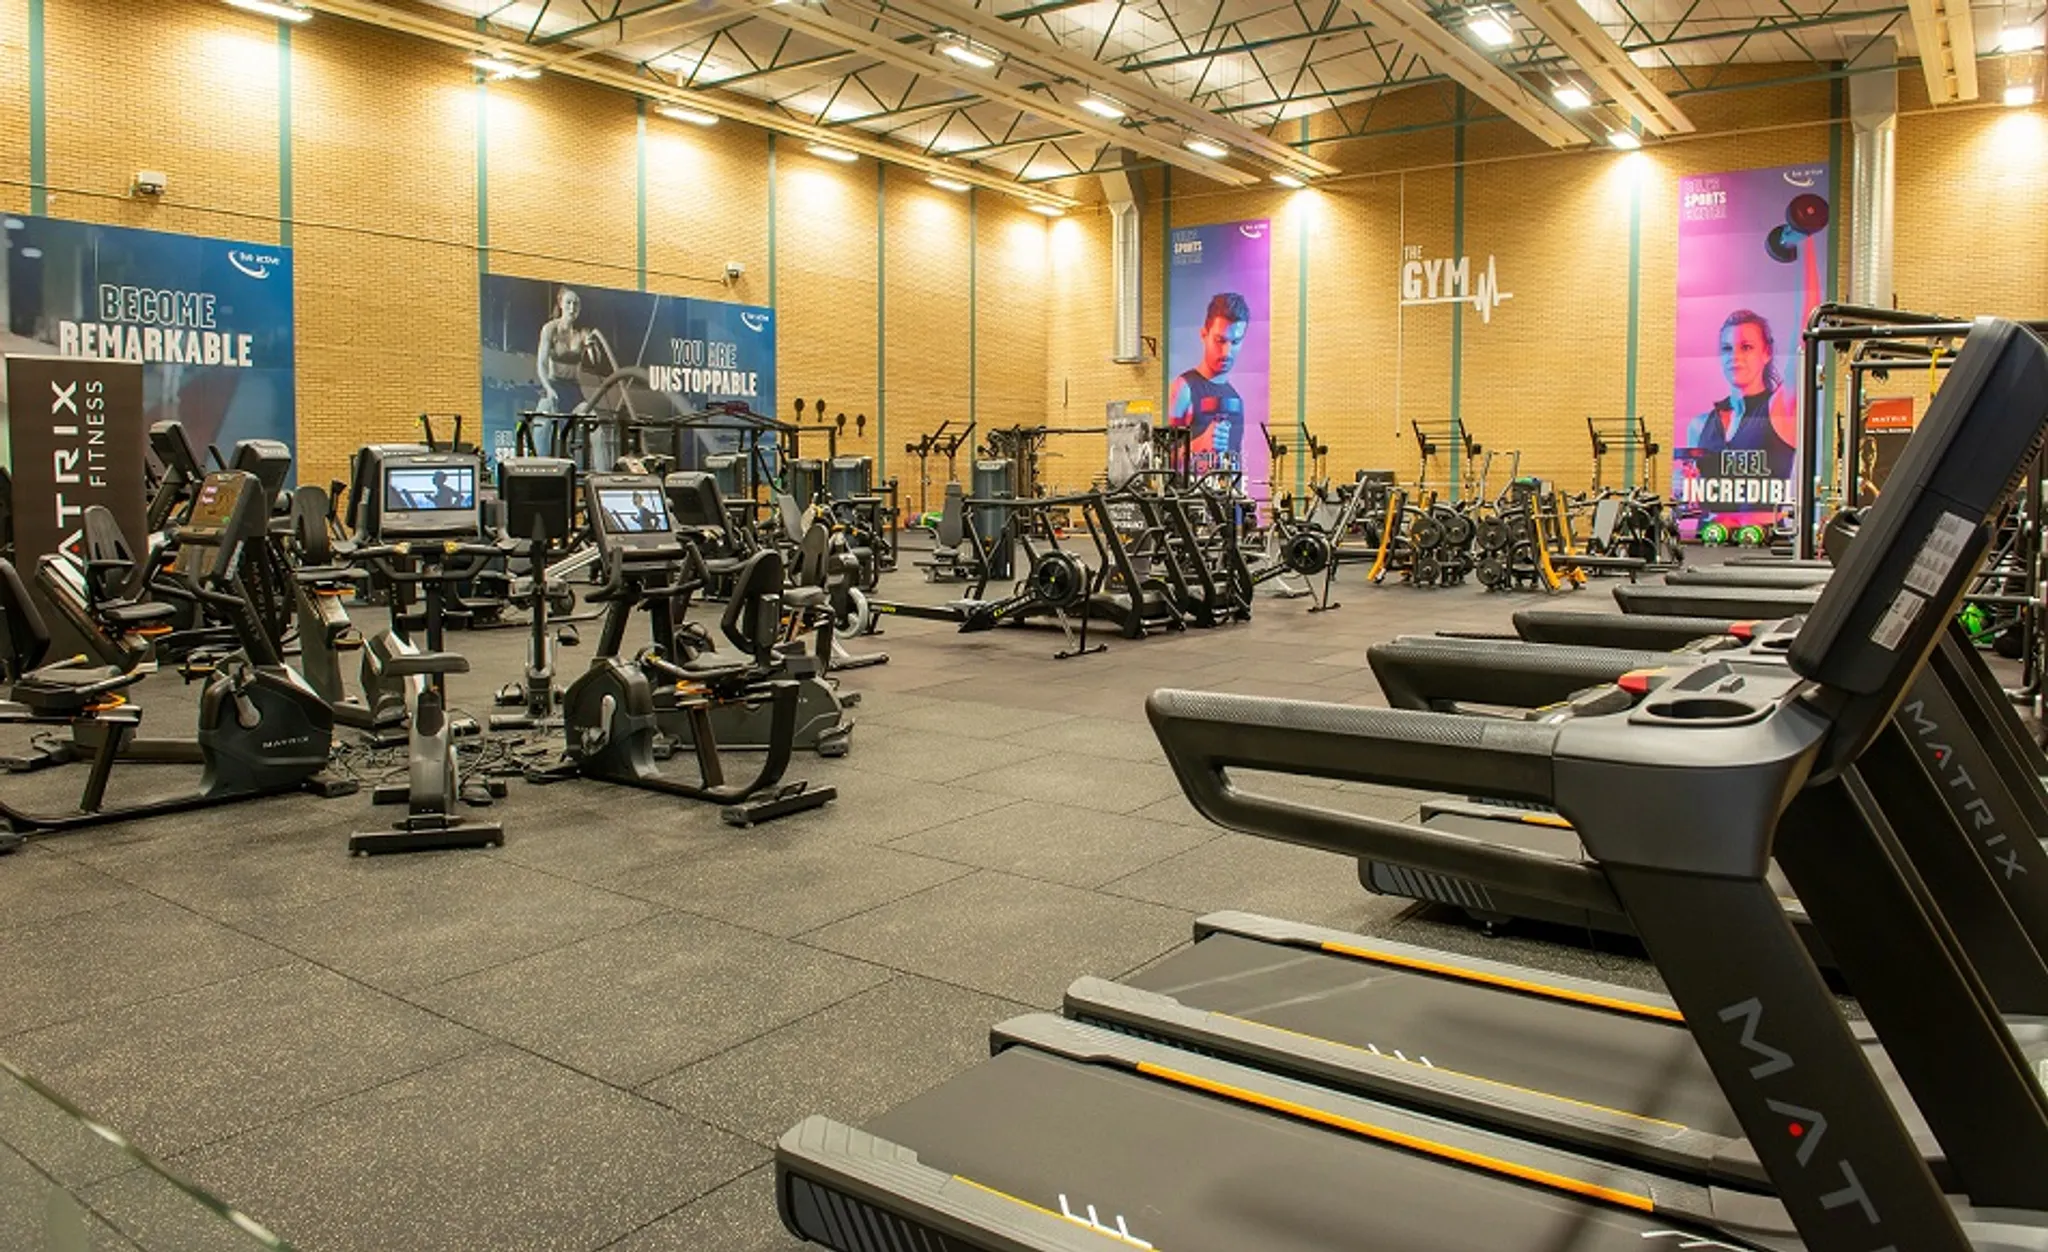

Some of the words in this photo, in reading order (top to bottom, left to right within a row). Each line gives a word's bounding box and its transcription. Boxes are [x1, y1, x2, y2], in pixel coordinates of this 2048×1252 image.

[1683, 190, 1727, 209] SPORTS
[1404, 245, 1423, 260] THE
[1402, 256, 1470, 300] GYM
[100, 284, 217, 329] BECOME
[59, 320, 254, 368] REMARKABLE
[671, 337, 705, 367] YOU
[707, 341, 738, 370] ARE
[649, 364, 758, 397] UNSTOPPABLE
[86, 380, 107, 488] FITNESS
[51, 380, 85, 568] ATRIX
[1720, 449, 1772, 477] FEEL
[1683, 478, 1795, 503] INCREDIBL
[263, 736, 309, 748] MATRIX
[1904, 699, 2029, 881] MATRIX
[1716, 996, 1900, 1252] MAT
